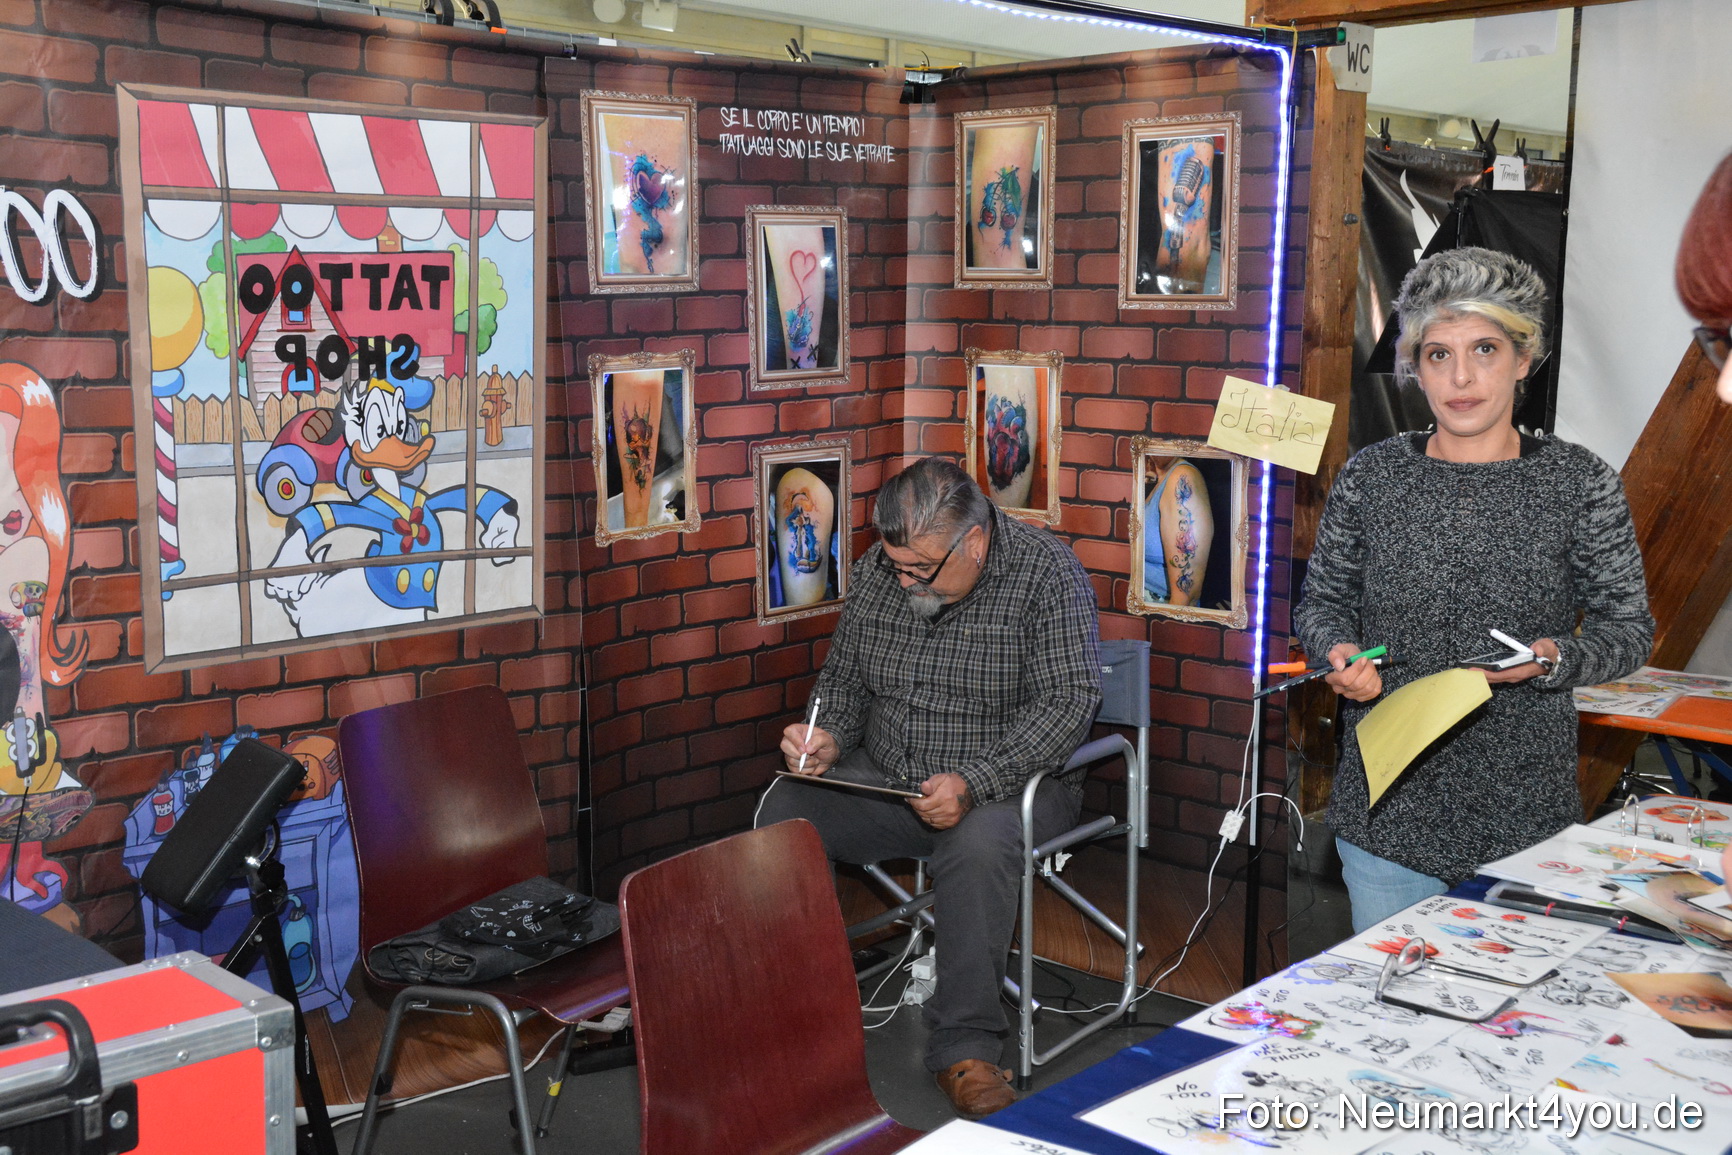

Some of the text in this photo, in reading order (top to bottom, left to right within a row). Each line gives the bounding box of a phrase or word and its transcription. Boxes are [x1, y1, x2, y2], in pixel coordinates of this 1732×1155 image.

[1347, 43, 1370, 74] WC
[719, 106, 740, 128] SE
[743, 108, 754, 128] IL
[757, 110, 790, 132] CORPO
[805, 116, 822, 134] UN
[823, 114, 861, 137] TEMPIO
[719, 133, 896, 164] TATUAGGI SONO LE SUE VETRATE
[0, 185, 98, 302] OO
[1220, 388, 1323, 447] Italia
